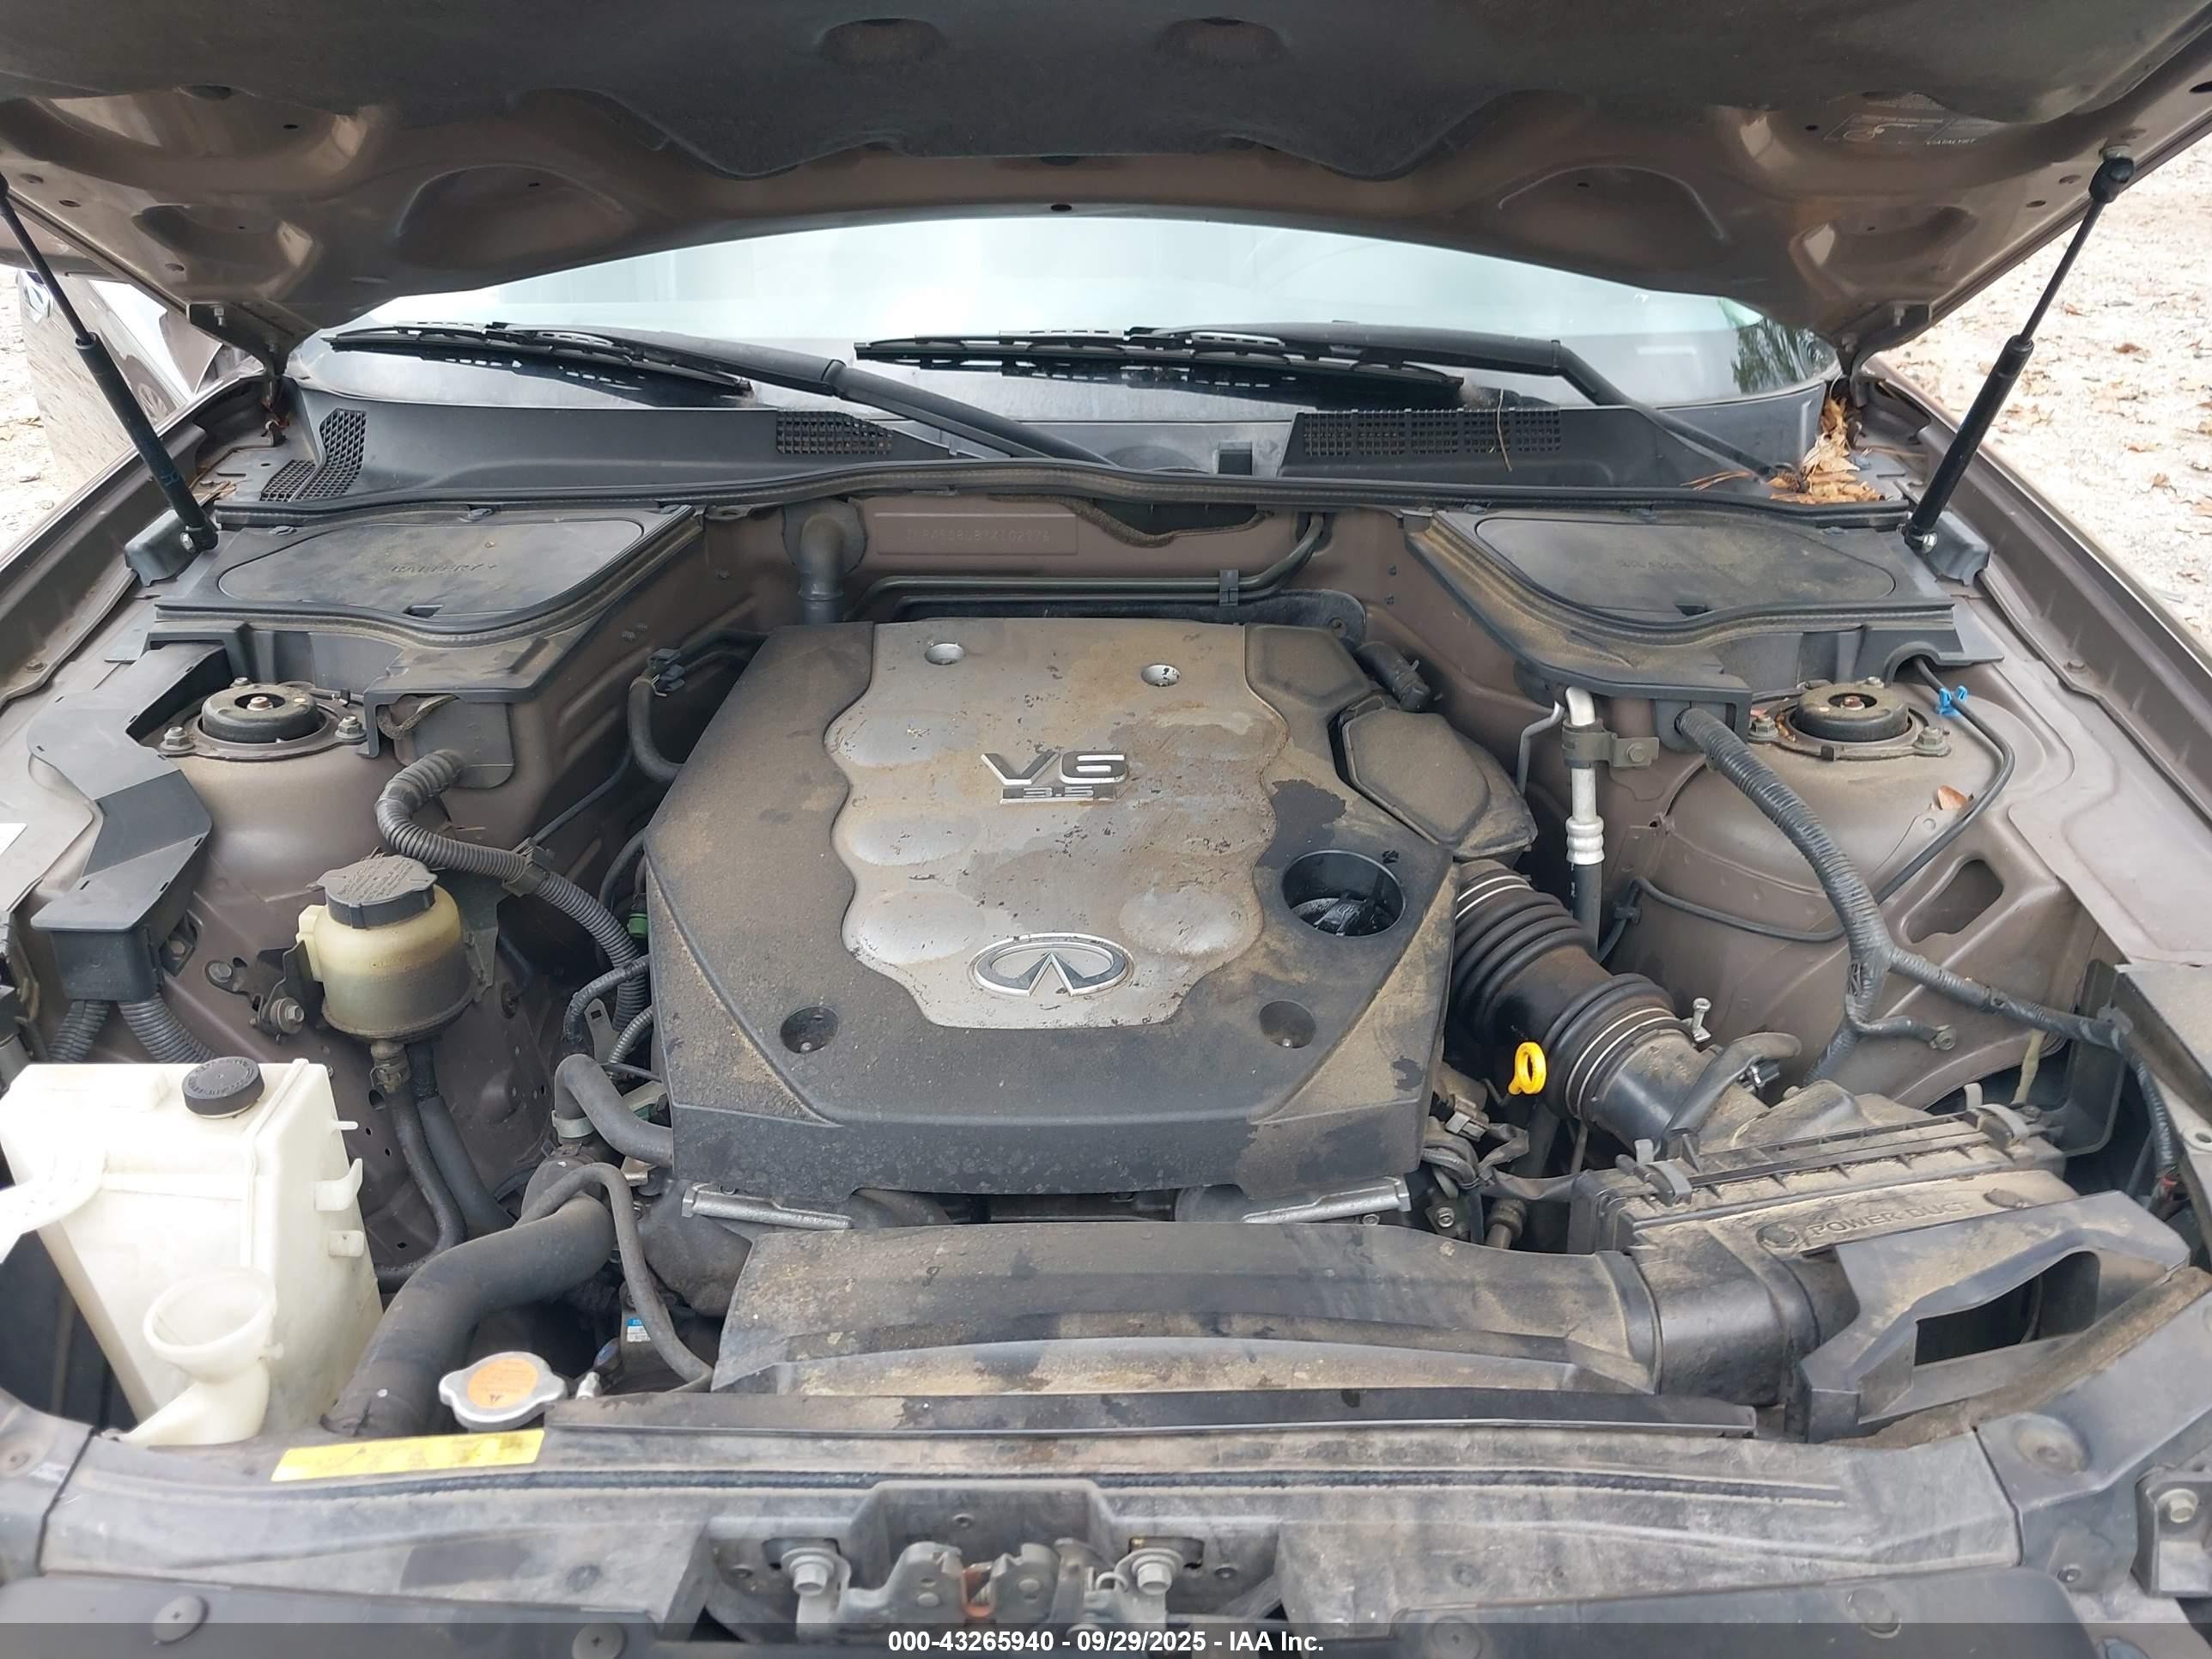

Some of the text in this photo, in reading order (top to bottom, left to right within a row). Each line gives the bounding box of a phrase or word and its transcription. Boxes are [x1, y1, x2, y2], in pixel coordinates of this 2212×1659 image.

[981, 750, 1129, 786] V6
[1023, 786, 1094, 799] 3.5
[1807, 1201, 1973, 1237] POWER DUCT
